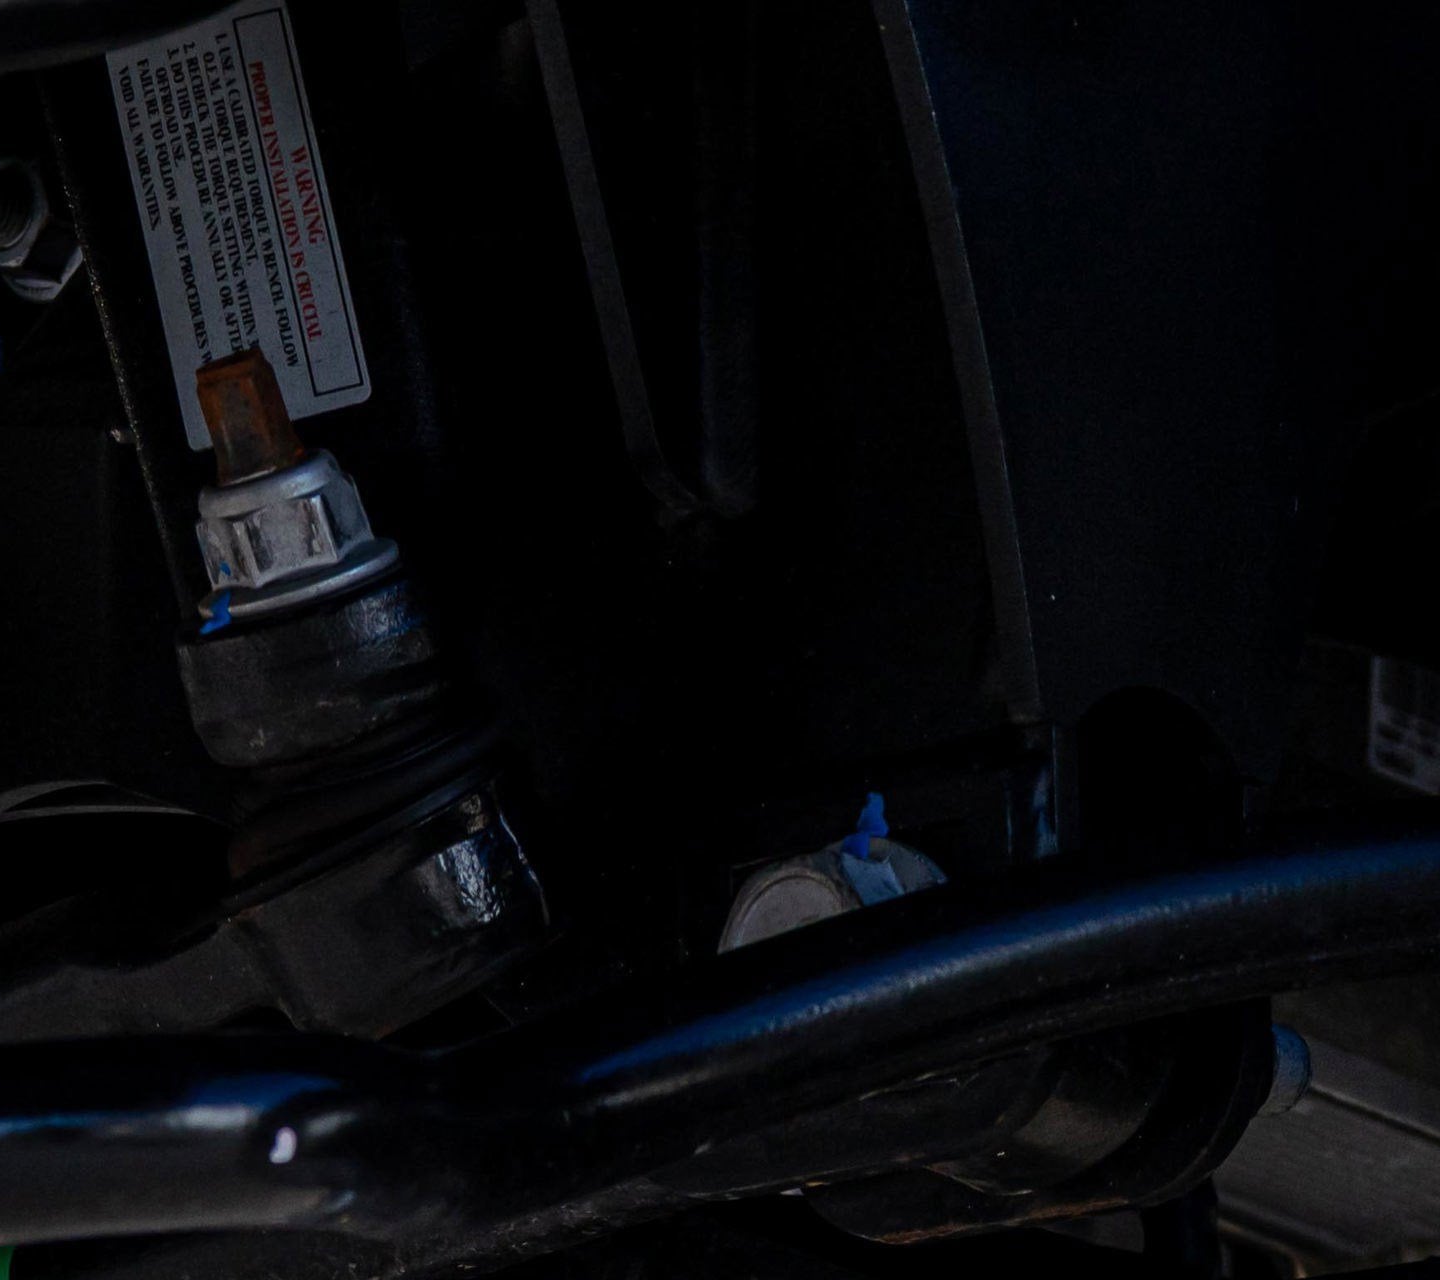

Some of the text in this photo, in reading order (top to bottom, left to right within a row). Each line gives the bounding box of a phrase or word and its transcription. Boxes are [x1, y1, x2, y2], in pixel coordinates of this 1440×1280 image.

[116, 65, 135, 103] VOID
[135, 59, 160, 117] FAILURE
[169, 62, 185, 84] DO
[217, 46, 235, 73] USE
[224, 76, 237, 86] A
[153, 67, 180, 134] OFFROAD
[174, 86, 193, 119] THIS
[184, 56, 211, 122] RECHECK
[125, 106, 142, 133] ALL
[149, 119, 164, 140] TO
[199, 125, 218, 153] THE
[210, 97, 237, 155] TORQUE
[225, 87, 259, 175] CALIBRATED
[154, 142, 179, 201] FOLLOW
[182, 121, 213, 207] PROCEDURE
[205, 156, 232, 215] TORQUE
[245, 177, 271, 238] TORQUE
[247, 61, 323, 341] PROPER INSTALLATION IS CRUCIAL
[287, 145, 327, 244] WARNING
[167, 205, 189, 253] ABOVE
[200, 209, 230, 283] ANNUALLY
[219, 216, 246, 277] SETTING
[177, 254, 211, 349] PROCEDURES
[218, 285, 234, 307] OR
[233, 279, 258, 335] WITHIN
[274, 307, 299, 367] FOLLOW
